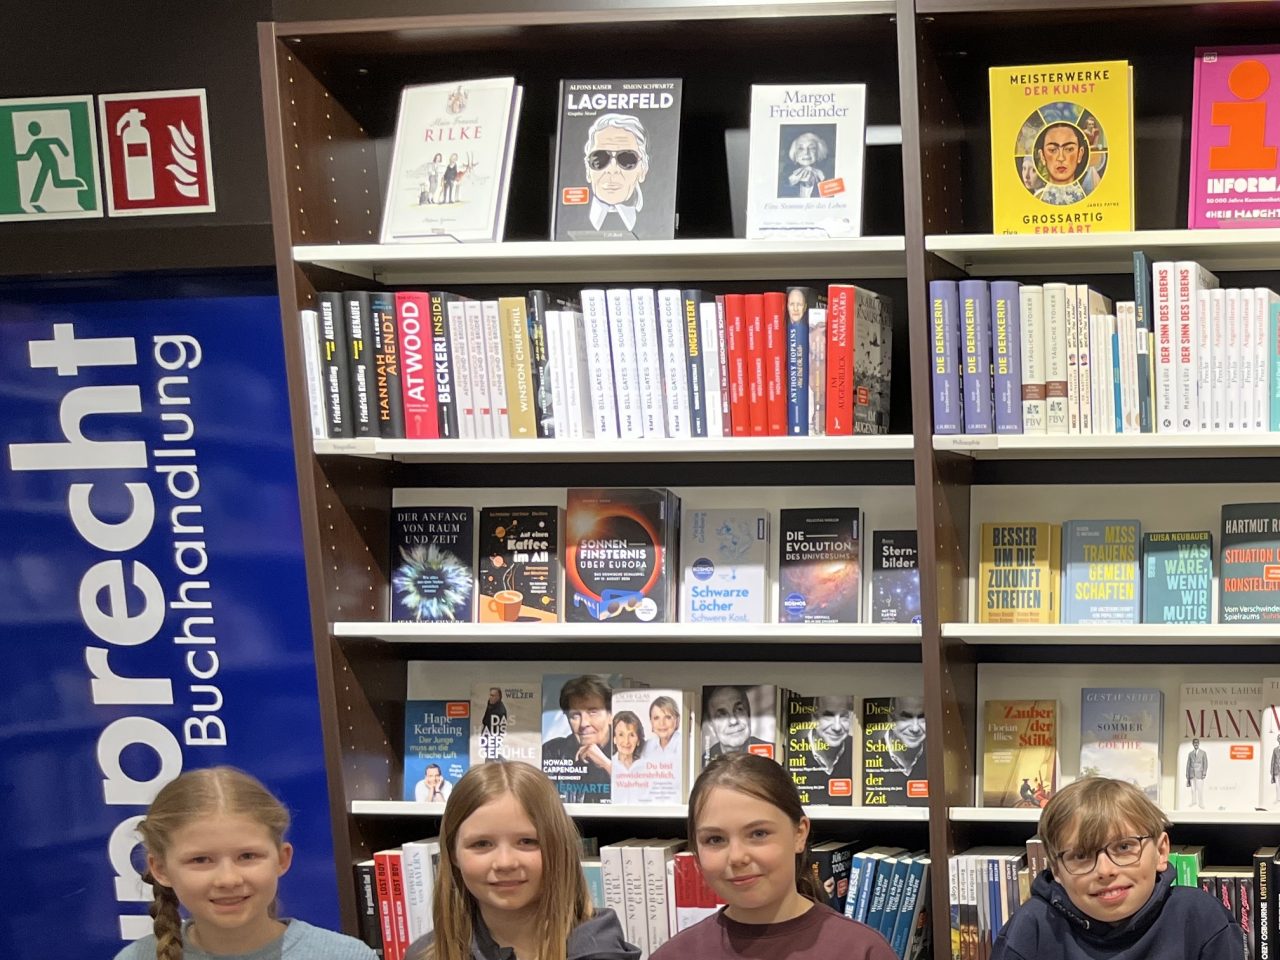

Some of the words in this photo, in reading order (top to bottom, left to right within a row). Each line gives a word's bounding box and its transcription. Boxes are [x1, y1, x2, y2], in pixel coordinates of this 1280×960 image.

[1010, 70, 1110, 84] MEISTERWERKE
[1025, 85, 1048, 96] DER
[1053, 83, 1096, 94] KUNST
[567, 92, 674, 110] LAGERFELD
[783, 90, 835, 105] Margot
[769, 105, 849, 118] Friedländer
[424, 126, 483, 142] RILKE
[1023, 212, 1103, 224] GROSSARTIG
[1159, 270, 1168, 302] LEBENS
[1159, 305, 1169, 321] DES
[685, 299, 698, 356] UNGEFILTERT
[934, 299, 944, 354] DENKERIN
[996, 299, 1007, 354] DENKERIN
[1160, 323, 1170, 344] SINN
[382, 313, 397, 375] ARENDT
[402, 302, 426, 401] ATWOOD
[1160, 347, 1170, 363] DER
[935, 356, 945, 374] DIE
[998, 357, 1008, 374] DIE
[376, 355, 390, 420] HANNAH
[398, 513, 418, 522] DER
[422, 512, 467, 521] ANFANG
[402, 524, 426, 533] VON
[429, 524, 460, 533] RAUM
[1226, 519, 1269, 534] HARTMUT
[154, 335, 227, 746] Buchhandlung
[405, 535, 429, 544] UND
[432, 535, 458, 544] ZEIT
[786, 531, 804, 540] DIE
[993, 527, 1037, 546] BESSER
[1105, 526, 1135, 543] MISS
[1150, 534, 1170, 542] LUISA
[1172, 533, 1208, 541] NEUBAUER
[507, 539, 549, 550] Kaffee
[581, 539, 627, 549] SONNEN
[786, 541, 851, 551] EVOLUTION
[882, 546, 917, 556] Stern-
[581, 550, 647, 559] FINSTERNIS
[994, 548, 1012, 567] UM
[1016, 548, 1036, 566] DIE
[1083, 545, 1135, 561] TRAUENS
[1178, 545, 1208, 558] WAS
[1225, 549, 1272, 563] SITUATION
[882, 557, 915, 568] bilder
[988, 569, 1041, 588] ZUKUNFT
[1088, 564, 1135, 581] GEMEIN
[1167, 575, 1207, 589] WENN
[692, 586, 749, 598] Schwarze
[1075, 583, 1134, 600] SCHAFTEN
[1181, 591, 1207, 605] WIR
[692, 599, 733, 611] Löcher
[988, 590, 1041, 609] STREITEN
[1164, 606, 1207, 621] MUTIG
[10, 323, 183, 941] pprecht
[866, 702, 895, 715] Diese
[1004, 705, 1054, 720] Zauber
[424, 713, 452, 725] Hape
[414, 724, 462, 737] Kerkeling
[866, 721, 896, 734] ganze
[1097, 723, 1143, 732] SOMMER
[866, 740, 907, 752] Scheiße
[1019, 733, 1053, 747] Stille
[478, 746, 536, 758] GEFÜHLE
[866, 757, 883, 767] mit
[866, 774, 884, 786] der
[866, 792, 887, 804] Zeit
